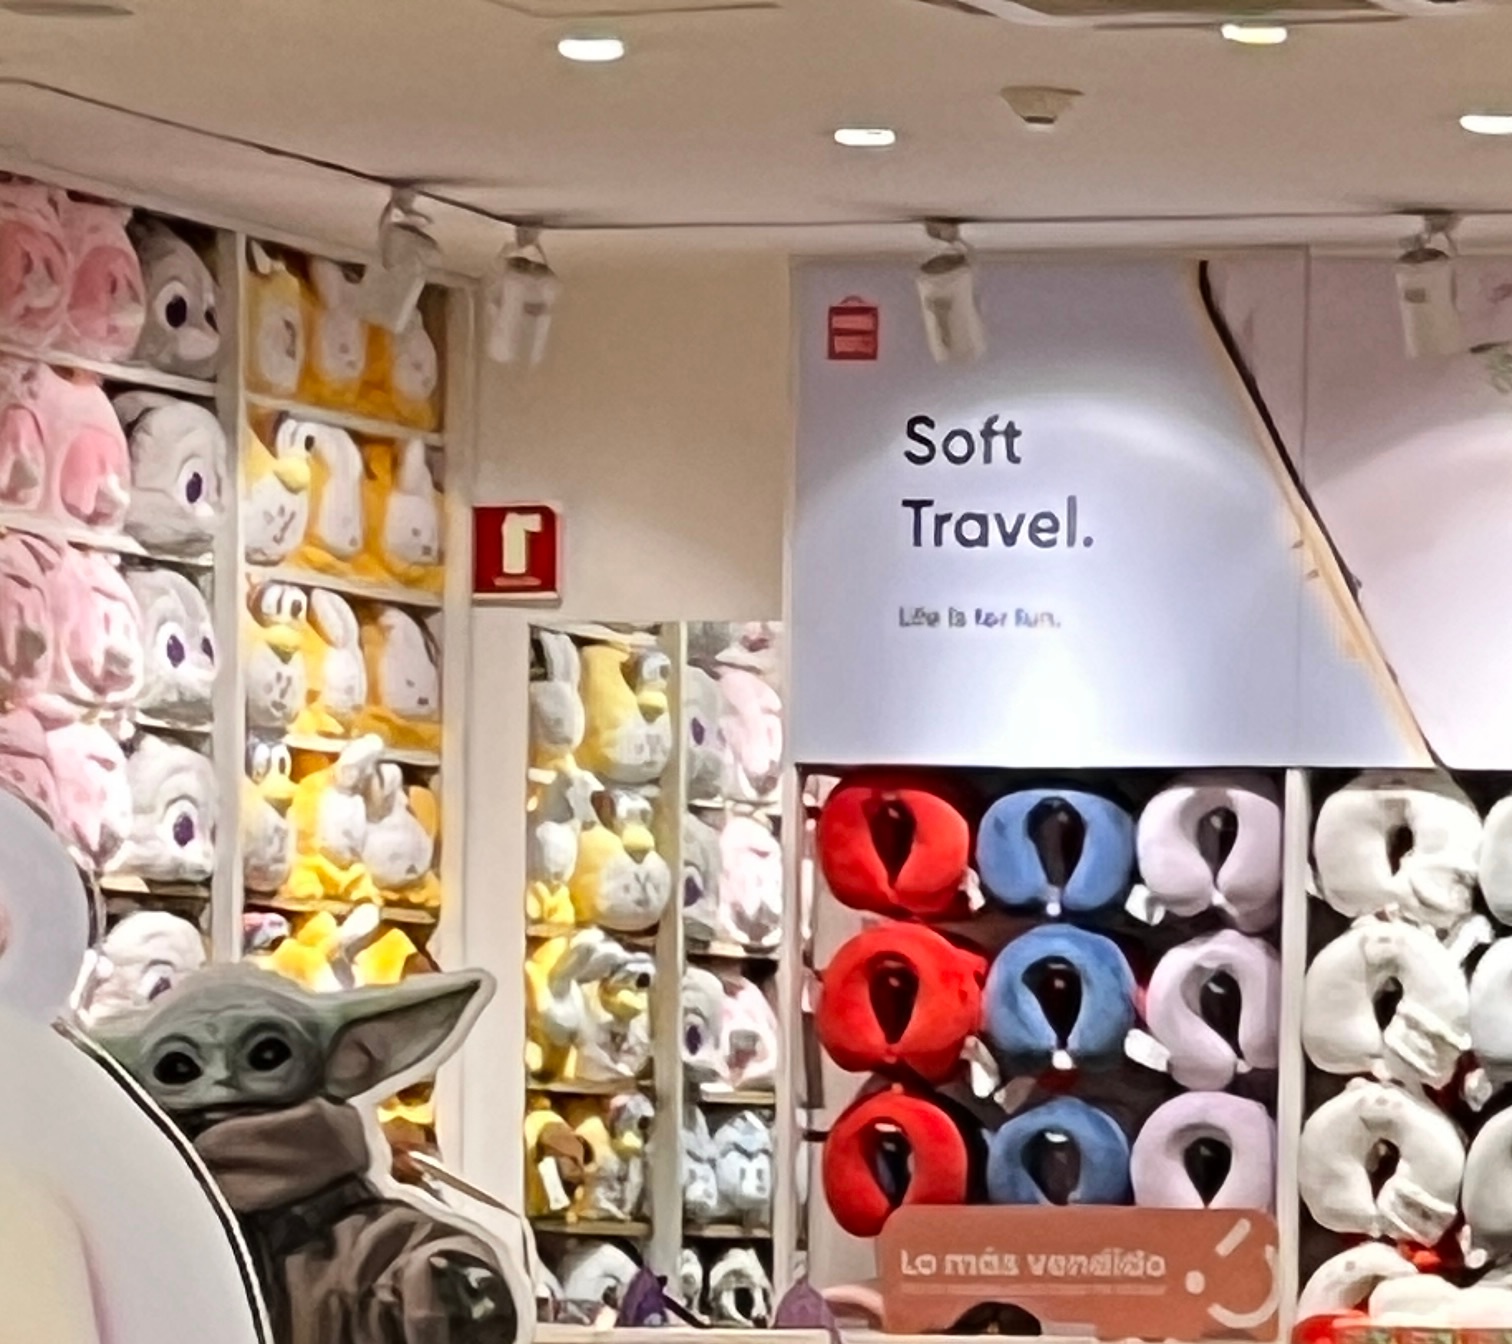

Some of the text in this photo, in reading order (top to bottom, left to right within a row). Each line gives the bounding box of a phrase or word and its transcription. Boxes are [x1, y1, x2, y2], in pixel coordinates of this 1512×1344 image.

[904, 414, 1022, 466] Soft
[902, 495, 1095, 549] Travel.
[901, 1247, 1167, 1278] Lo más vendido
